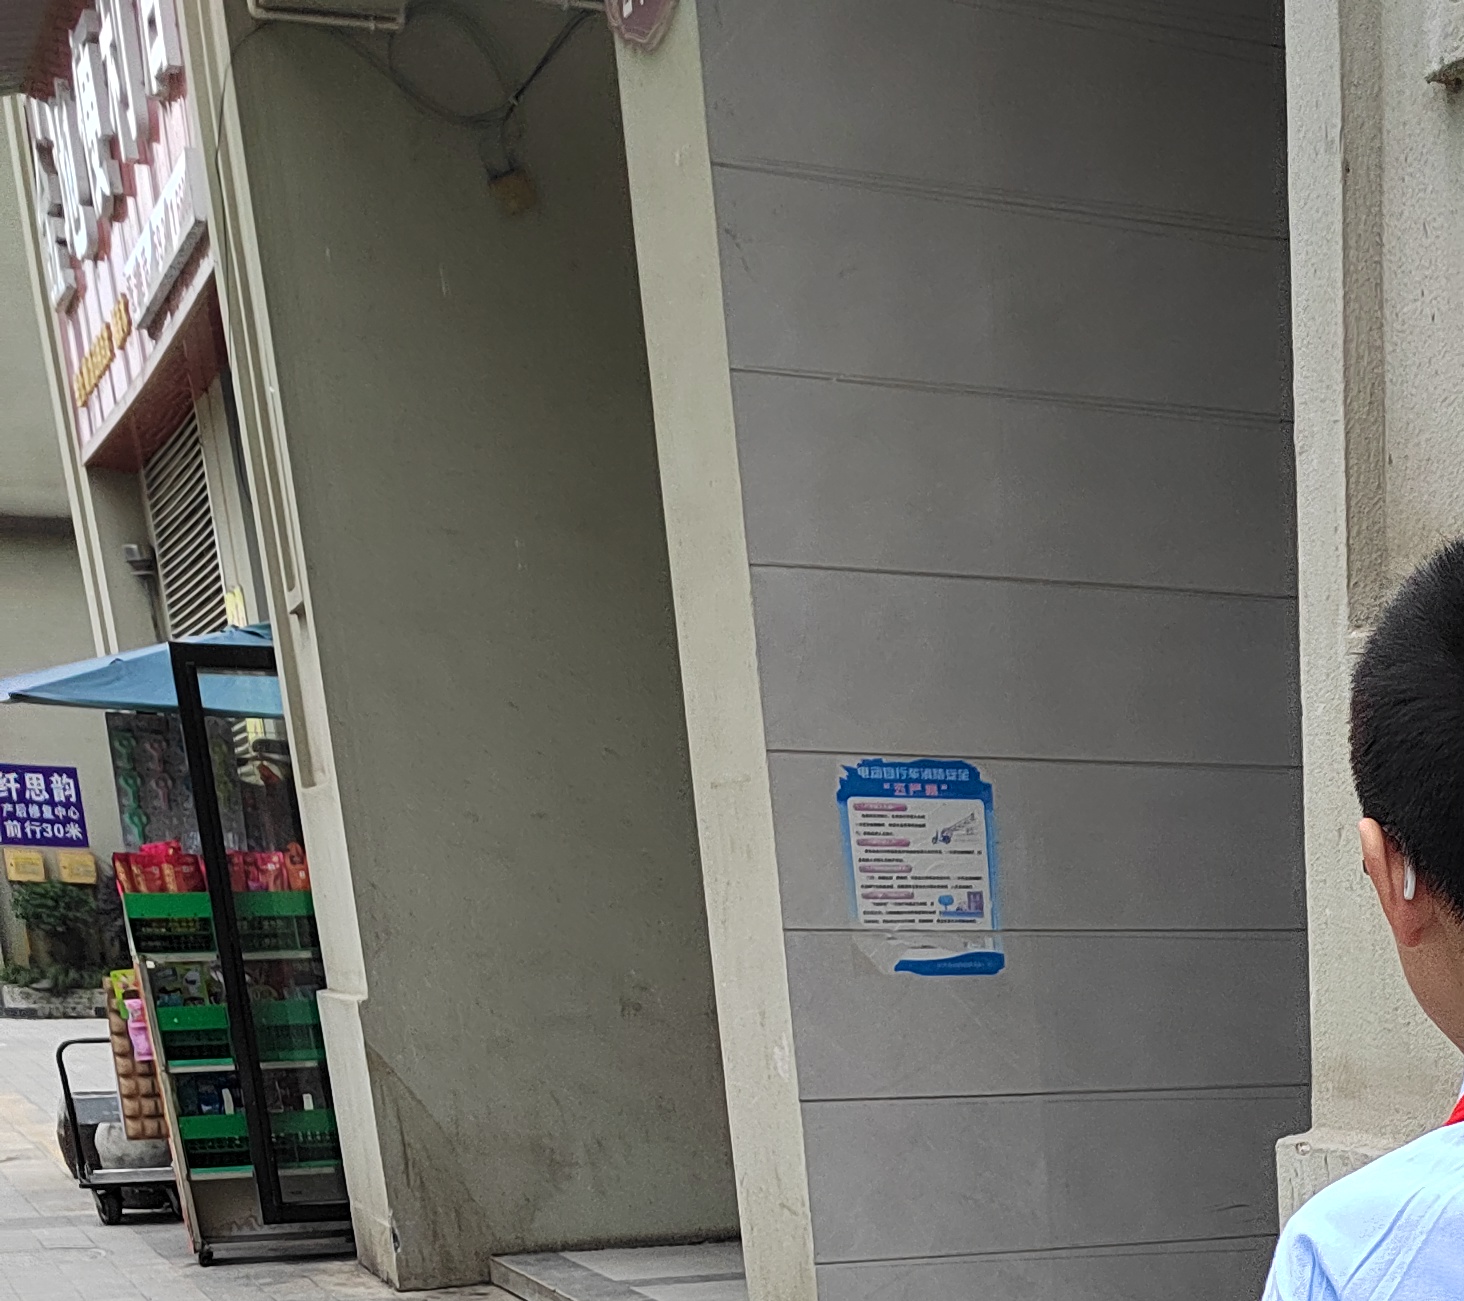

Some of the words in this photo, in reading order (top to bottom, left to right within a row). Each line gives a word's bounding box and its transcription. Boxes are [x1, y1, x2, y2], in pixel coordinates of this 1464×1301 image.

[0, 772, 77, 802] 纤思韵
[2, 802, 80, 820] 产后修复中心
[4, 819, 83, 840] 前行30米
